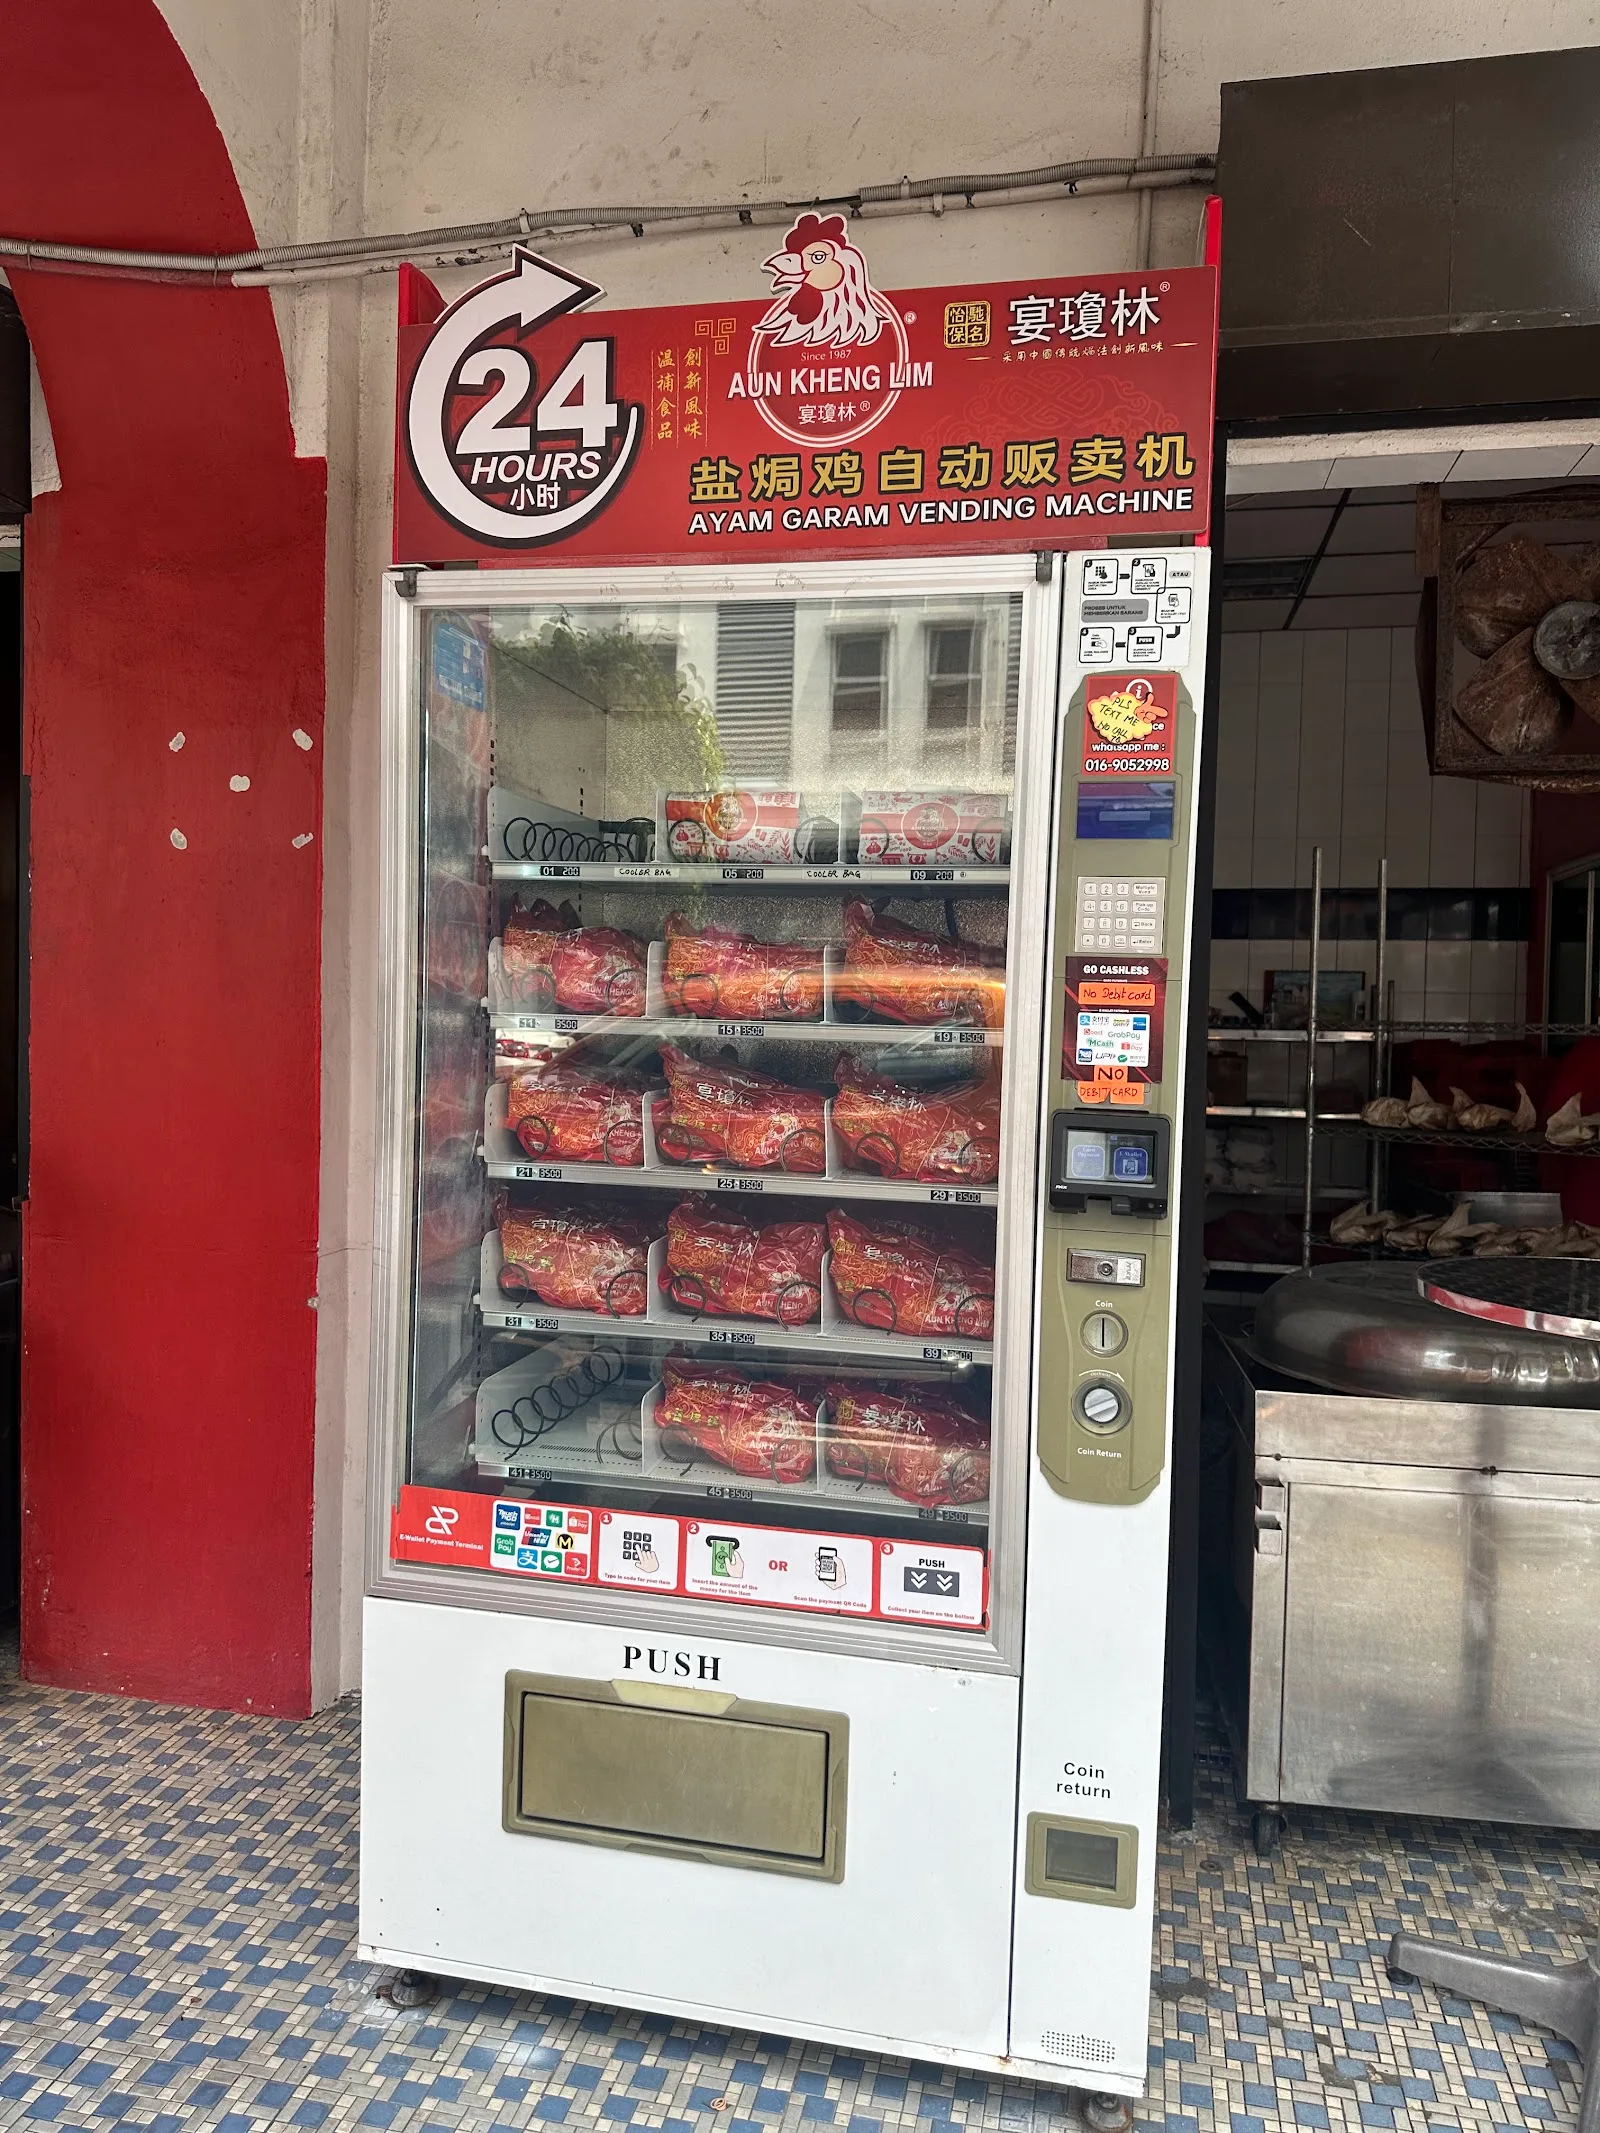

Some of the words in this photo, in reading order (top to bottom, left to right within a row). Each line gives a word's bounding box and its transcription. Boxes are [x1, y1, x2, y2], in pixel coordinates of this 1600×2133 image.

[801, 352, 827, 362] Since
[829, 349, 852, 360] 1987
[727, 371, 782, 399] AUN
[790, 363, 880, 395] KHENG
[890, 361, 934, 388] LIM
[456, 341, 618, 454] 24
[470, 451, 602, 485] HOURS
[510, 482, 561, 511] 小时
[689, 510, 774, 534] AYAM
[782, 504, 889, 531] GARAM
[899, 497, 1036, 524] VENDING
[1045, 488, 1193, 519] MACHINE
[1112, 697, 1132, 709] PLS
[1100, 704, 1122, 720] TEXT
[1124, 715, 1139, 726] ME
[1097, 721, 1110, 731] NO
[1112, 727, 1128, 739] CALL
[1092, 743, 1141, 753] whatsapp
[1085, 759, 1169, 771] 016-9052998
[543, 866, 555, 876] 01
[562, 867, 579, 876] 200
[619, 868, 651, 876] COOLER
[654, 868, 672, 876] BAG
[725, 869, 738, 878] 05
[746, 869, 763, 879] 200
[806, 870, 838, 878] COOLER
[843, 870, 862, 879] BAG
[913, 870, 926, 880] 09
[936, 871, 953, 880] 200
[1083, 965, 1098, 974] GO
[1100, 965, 1149, 975] CASHLESS
[1083, 988, 1097, 998] No
[1102, 987, 1126, 1000] Debit
[521, 1019, 533, 1028] 11
[720, 1026, 733, 1034] 15
[937, 1032, 950, 1041] 19
[1108, 1031, 1140, 1040] GrabPay
[1098, 1067, 1124, 1080] NO
[1080, 1087, 1110, 1097] DEBIT
[1112, 1087, 1138, 1097] CARD
[519, 1167, 531, 1176] 21
[720, 1179, 732, 1188] 25
[933, 1191, 946, 1200] 29
[1095, 1300, 1113, 1308] Coin
[508, 1317, 519, 1326] 31
[712, 1332, 724, 1341] 35
[926, 1348, 939, 1357] 39
[1077, 1448, 1095, 1456] Coin
[1096, 1449, 1122, 1458] Return
[511, 1467, 522, 1476] 41
[709, 1487, 721, 1496] 45
[921, 1509, 934, 1518] 49
[399, 1534, 425, 1543] E-Wallet
[426, 1537, 454, 1546] Payment
[455, 1541, 484, 1551] Terminal
[496, 1538, 514, 1546] Grab
[497, 1545, 512, 1553] Pay
[769, 1560, 788, 1572] OR
[918, 1558, 945, 1568] PUSH
[622, 1645, 721, 1681] PUSH
[1064, 1762, 1105, 1779] Coin
[1057, 1782, 1111, 1799] return
